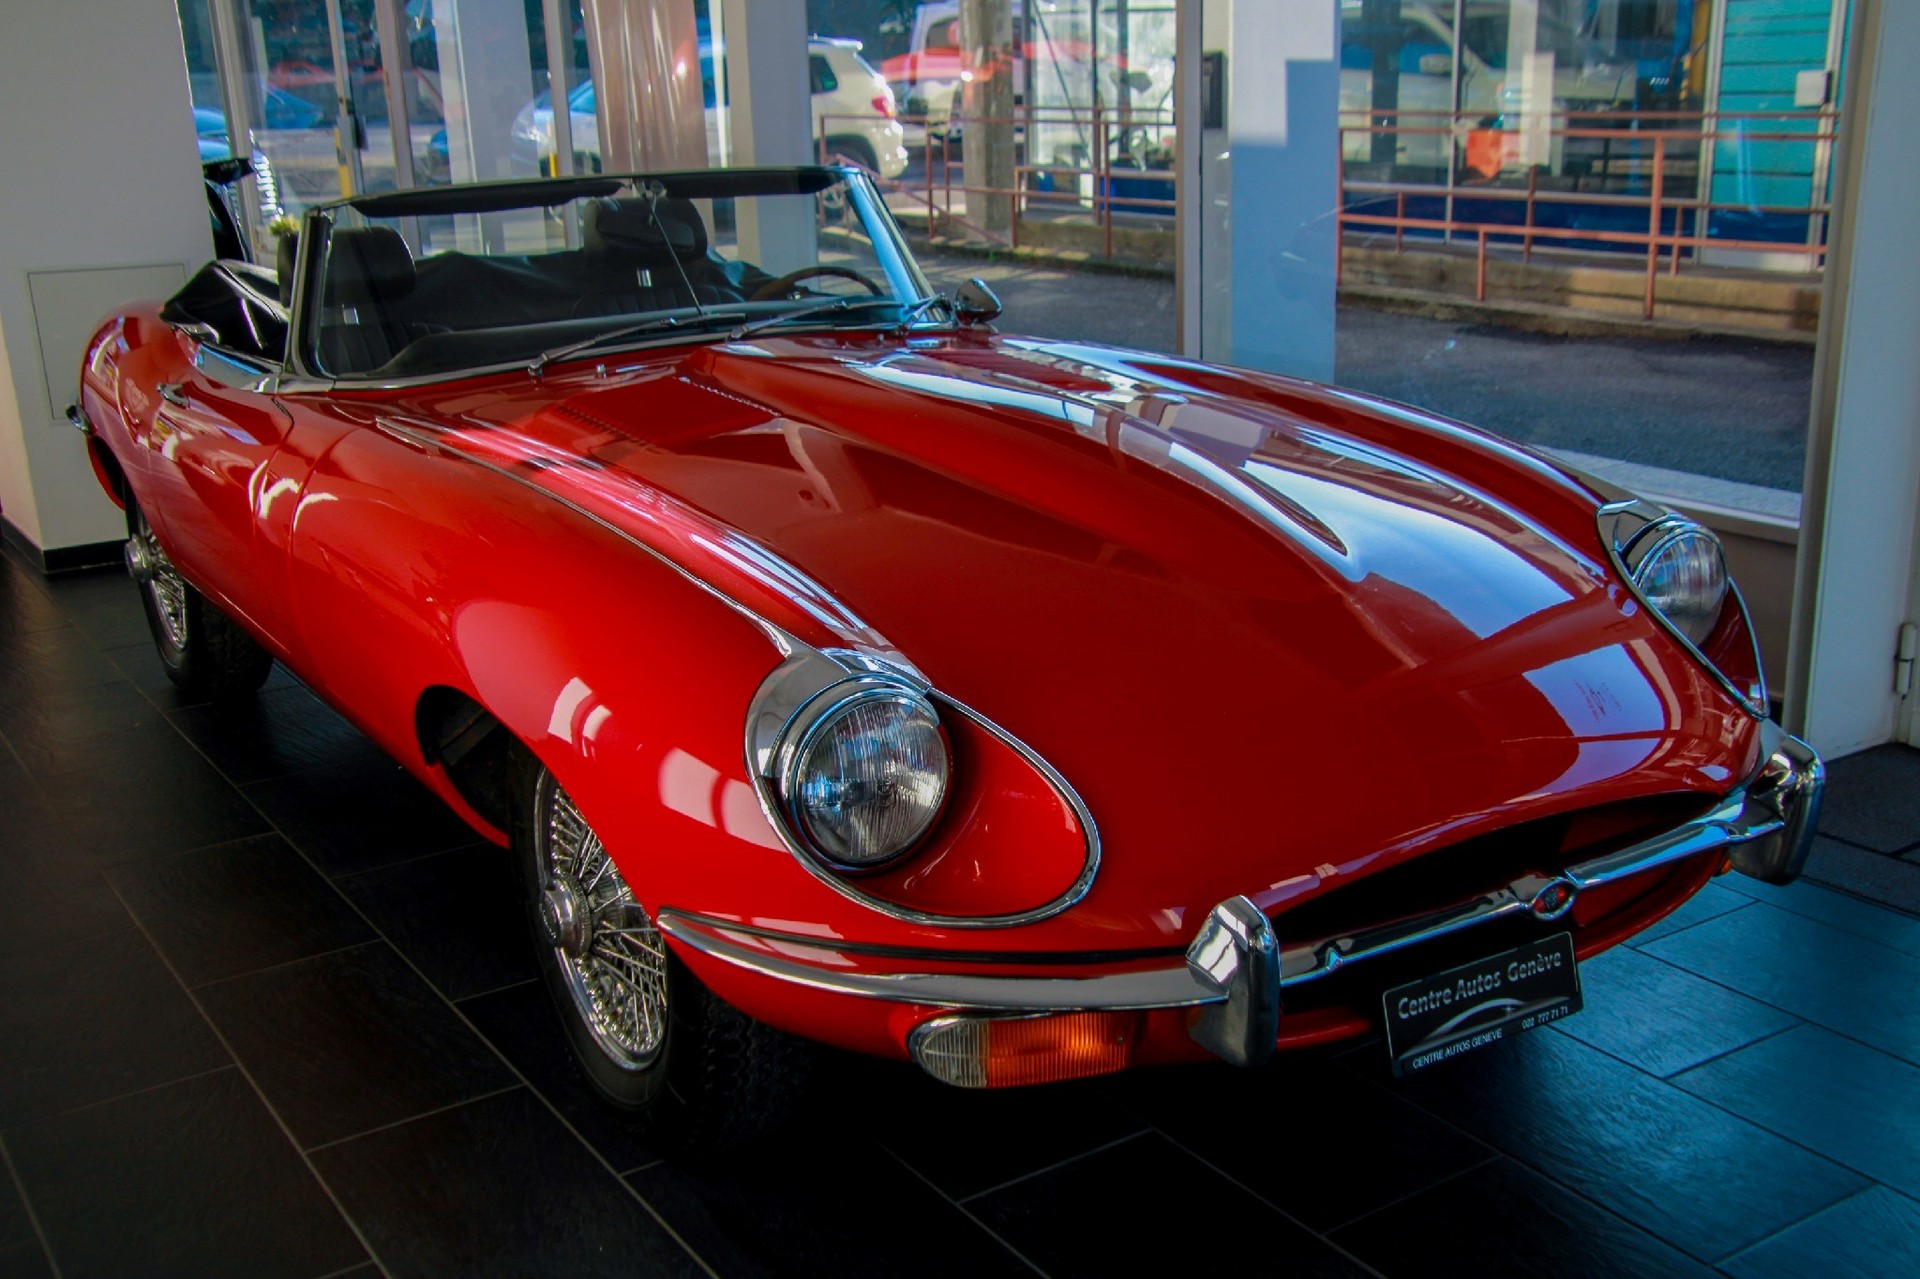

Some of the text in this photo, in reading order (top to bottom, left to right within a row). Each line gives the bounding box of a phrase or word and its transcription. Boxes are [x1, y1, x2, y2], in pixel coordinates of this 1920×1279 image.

[1398, 952, 1561, 1019] Centre Autos Genève
[1538, 1012, 1550, 1024] 777
[1551, 1009, 1560, 1020] 71
[1561, 1005, 1569, 1015] 71
[1413, 1028, 1503, 1069] CENTRE AUTOS GENEVE
